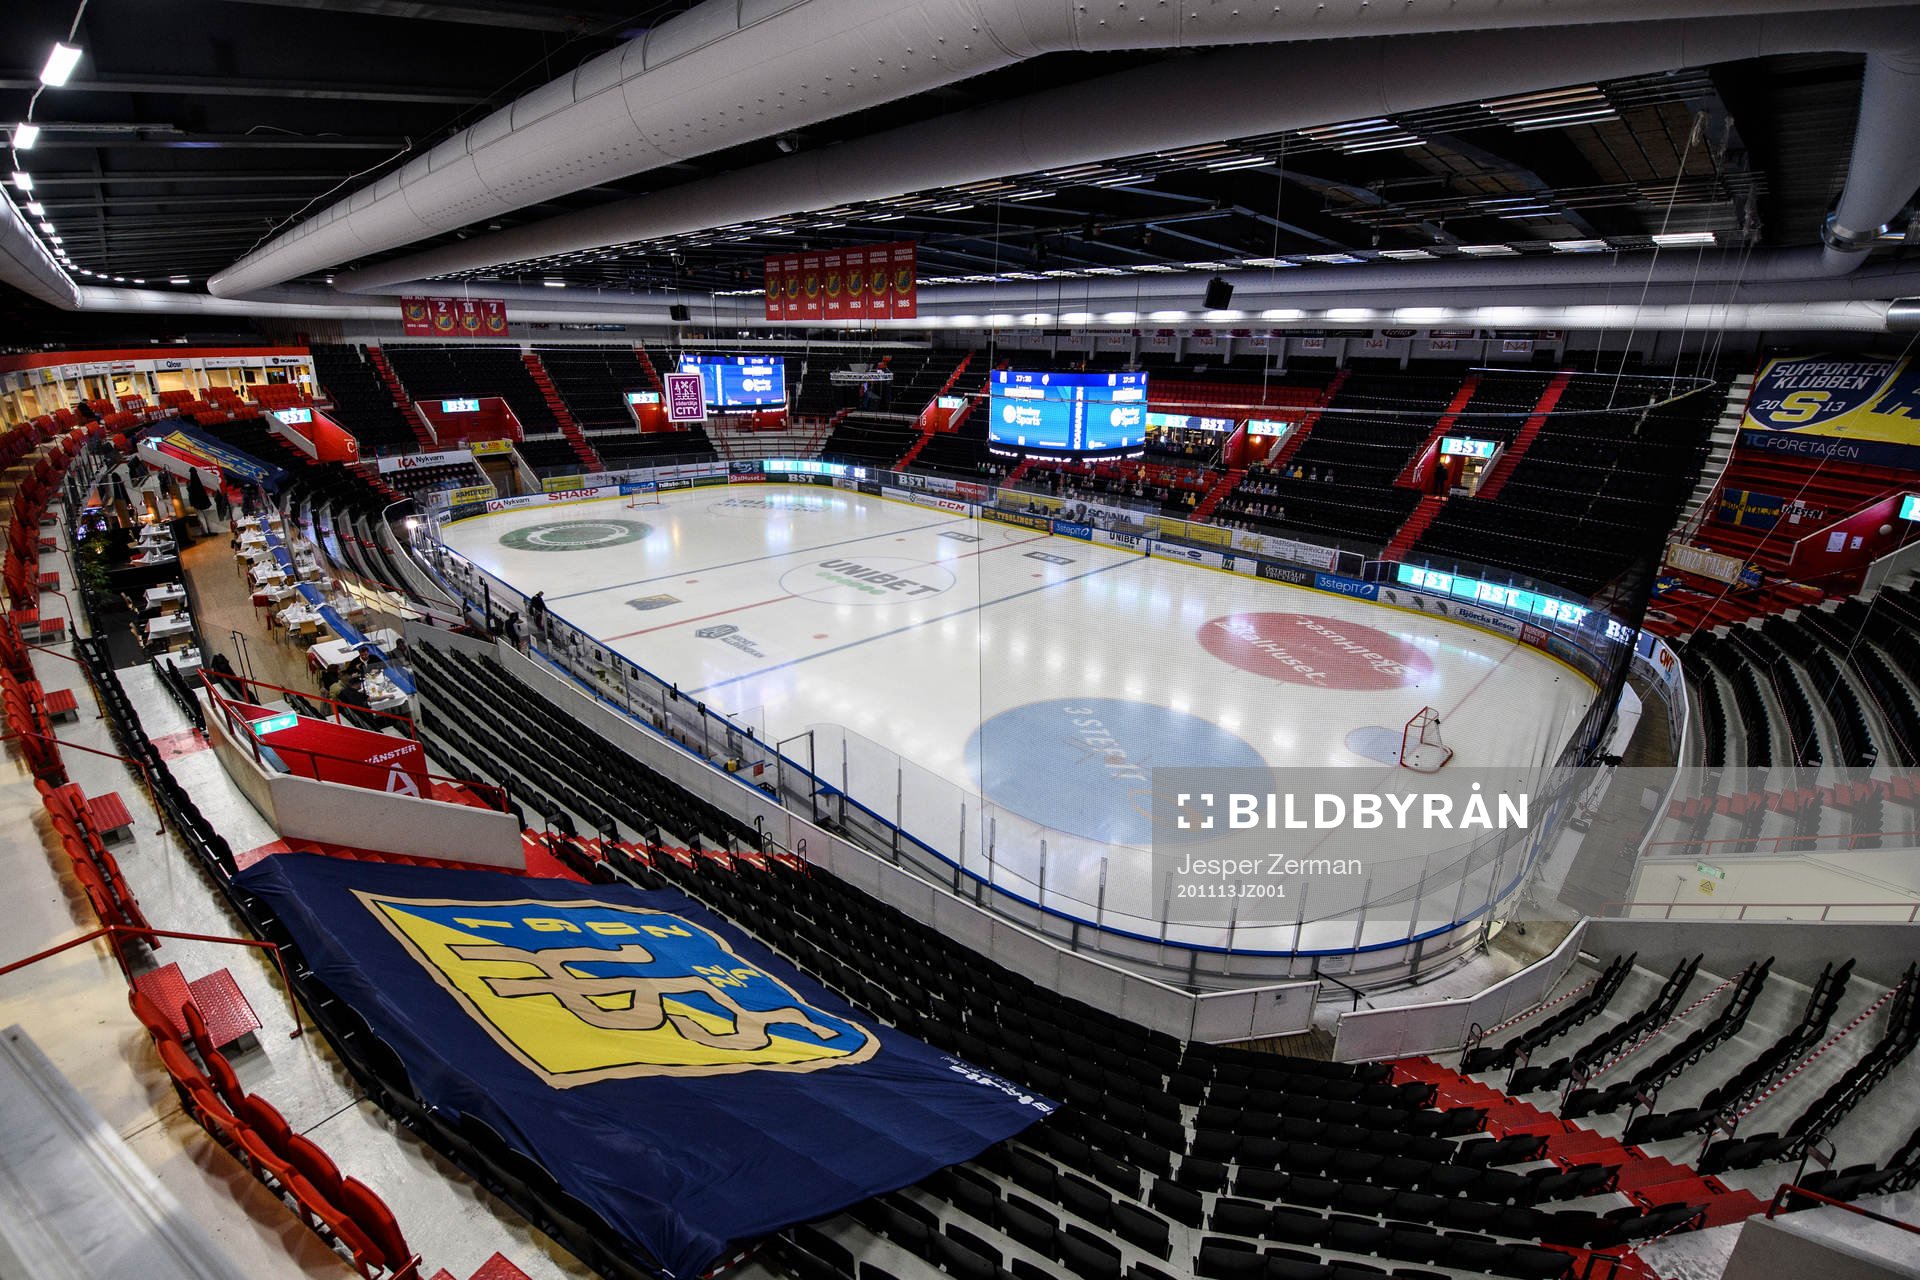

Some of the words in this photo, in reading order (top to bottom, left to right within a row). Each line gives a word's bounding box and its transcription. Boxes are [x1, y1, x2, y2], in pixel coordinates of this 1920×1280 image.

[438, 301, 447, 312] 2
[463, 301, 475, 313] 11
[489, 303, 497, 313] 7
[1772, 362, 1893, 378] SUPPORTER
[1773, 375, 1872, 390] KLUBBEN
[676, 407, 698, 416] CITY
[1756, 399, 1781, 410] 20
[1769, 390, 1833, 423] S
[1822, 401, 1847, 412] 13
[347, 441, 354, 453] C
[1766, 436, 1860, 459] FÖRETAGEN
[398, 457, 417, 468] ICA
[416, 455, 445, 464] Nykvarn
[788, 473, 816, 484] BST
[899, 475, 925, 489] BST
[548, 488, 600, 501] SHARP
[488, 501, 504, 512] ICA
[503, 496, 530, 506] Nykvarn
[937, 500, 966, 512] CCM
[1087, 508, 1132, 524] SCANIA
[1109, 532, 1141, 546] UNIBET
[818, 559, 942, 596] UNIBET
[1411, 566, 1452, 591] BST
[1320, 577, 1361, 594] 3stepIT
[1475, 580, 1520, 606] BST
[1543, 598, 1588, 625] BST
[1458, 607, 1491, 623] Björcks
[1491, 617, 1517, 632] Resor
[386, 762, 421, 798] A
